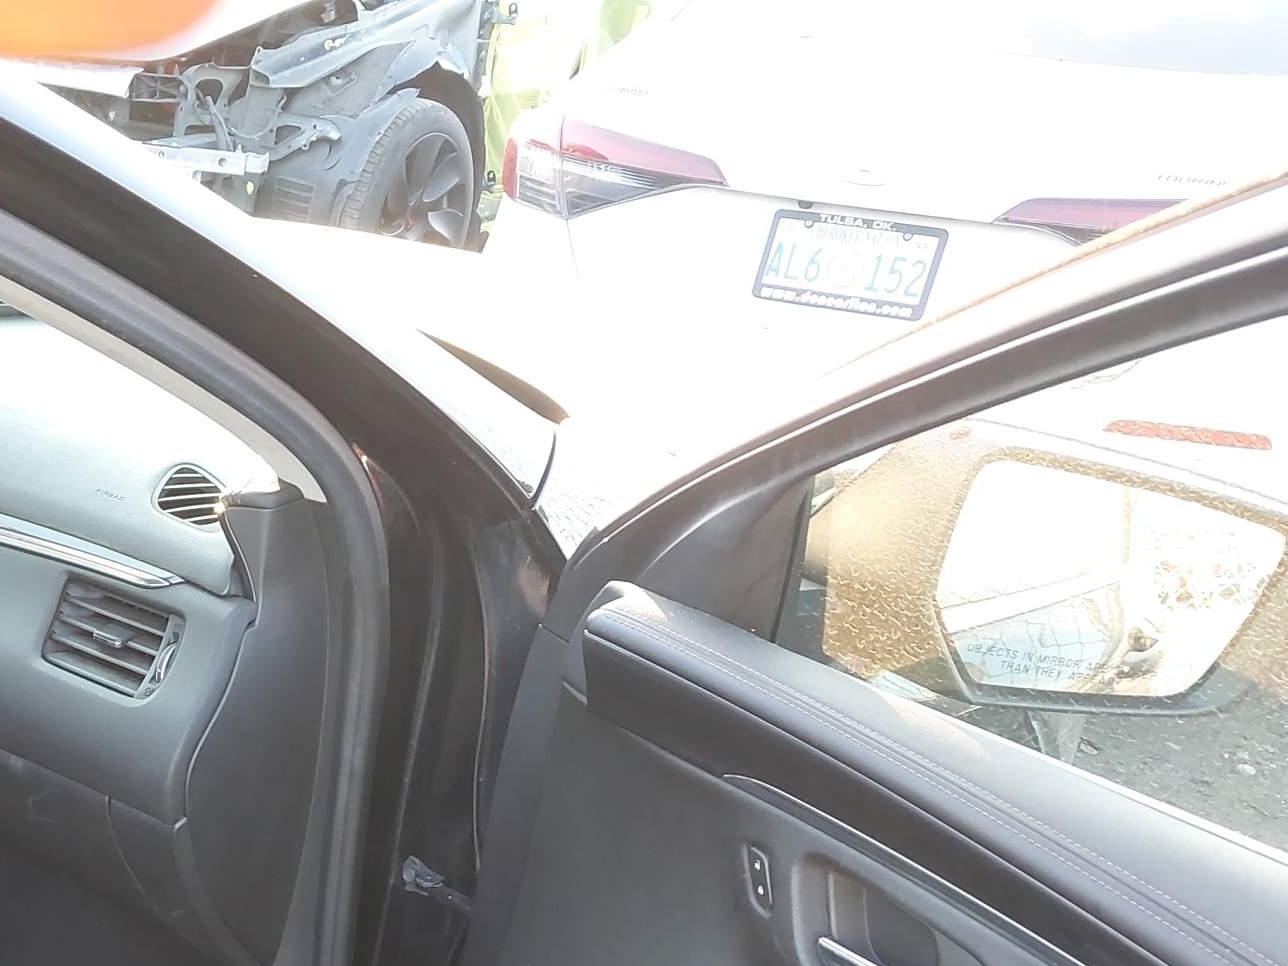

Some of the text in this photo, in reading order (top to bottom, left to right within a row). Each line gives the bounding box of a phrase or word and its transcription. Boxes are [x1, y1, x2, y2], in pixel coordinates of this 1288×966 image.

[819, 213, 897, 231] TULSA, OK.
[764, 240, 927, 298] AL6 152
[967, 642, 1020, 660] OBJECTS
[1023, 650, 1035, 662] IN
[1038, 653, 1081, 669] MIRROR
[1000, 660, 1031, 674] THAN
[1034, 665, 1062, 679] THEY
